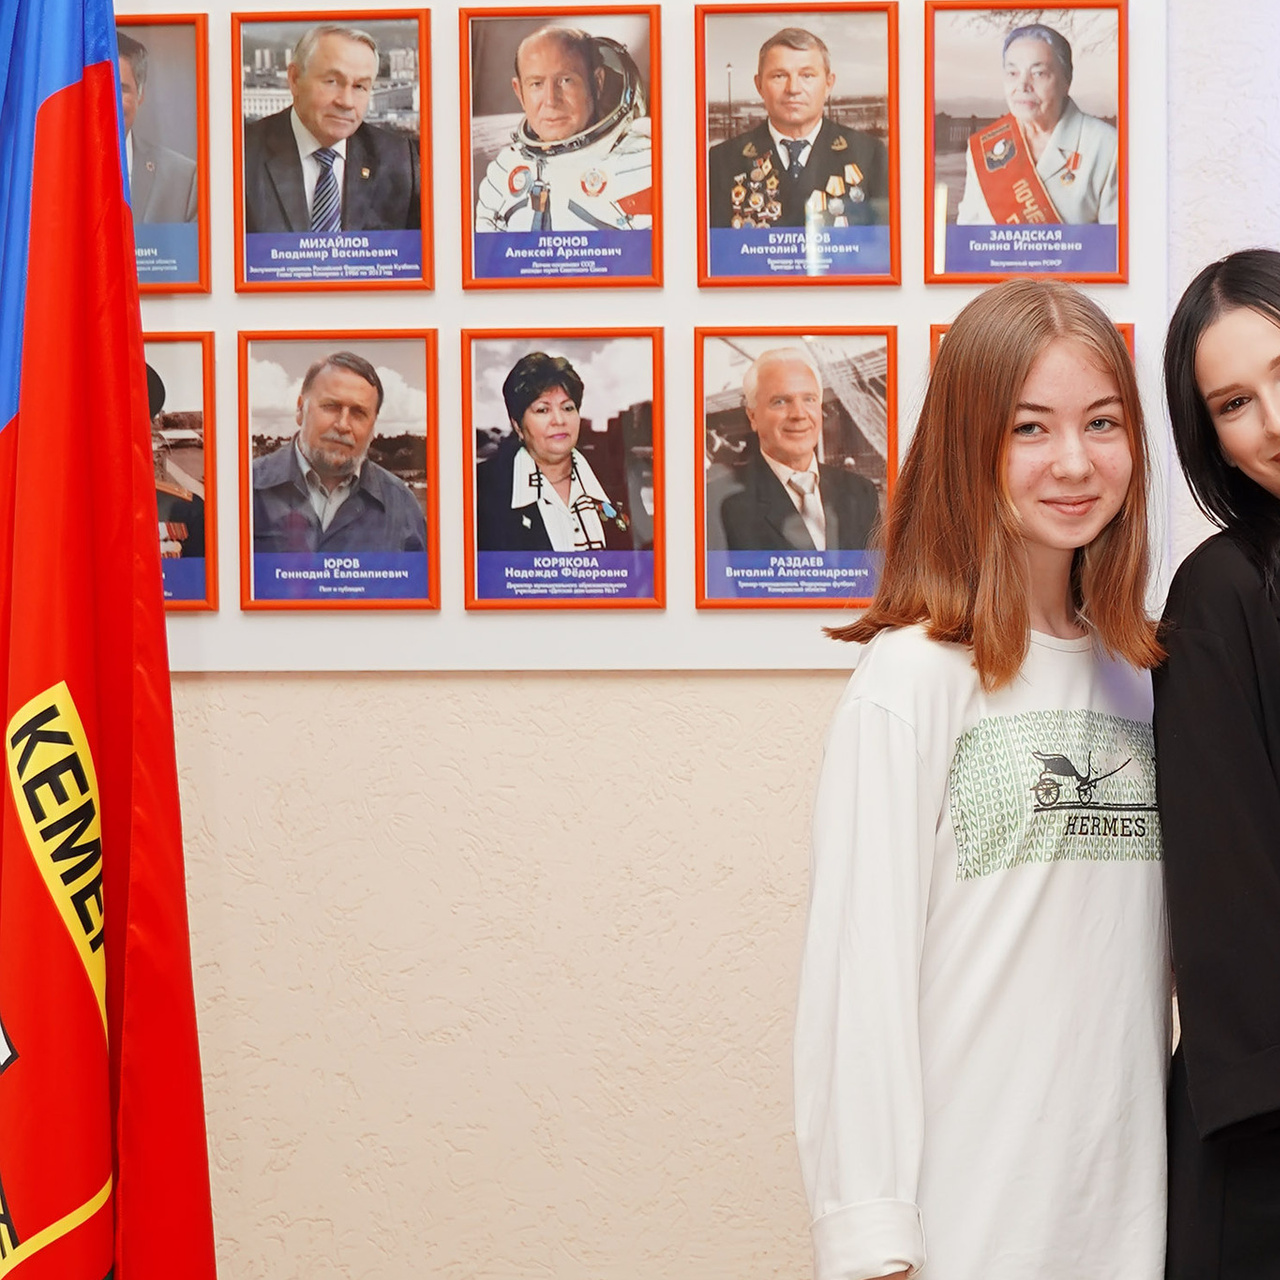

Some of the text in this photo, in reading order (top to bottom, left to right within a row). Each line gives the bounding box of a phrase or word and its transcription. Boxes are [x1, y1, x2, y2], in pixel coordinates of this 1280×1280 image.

[299, 236, 370, 249] МИХАЙЛОВ
[538, 236, 589, 248] ЛЕОНОВ
[768, 233, 831, 244] БУЛГАОВ
[989, 230, 1062, 242] ЗАВАДСКАЯ
[740, 243, 860, 255] Анатолий Ианович
[969, 240, 1083, 252] Галина Игнатьевна
[270, 246, 399, 261] Владимир Васильевич
[505, 246, 623, 260] Алексей Архипович
[323, 558, 360, 570] ЮРОВ
[533, 557, 600, 568] КОРЯКОВА
[770, 556, 824, 569] РАЗДАЕВ
[275, 568, 409, 581] Геннадий Евлампиевич
[504, 566, 629, 580] Надежда Фёдоровна
[725, 566, 869, 580] Виталий Александрович
[1064, 816, 1146, 838] HERMES
